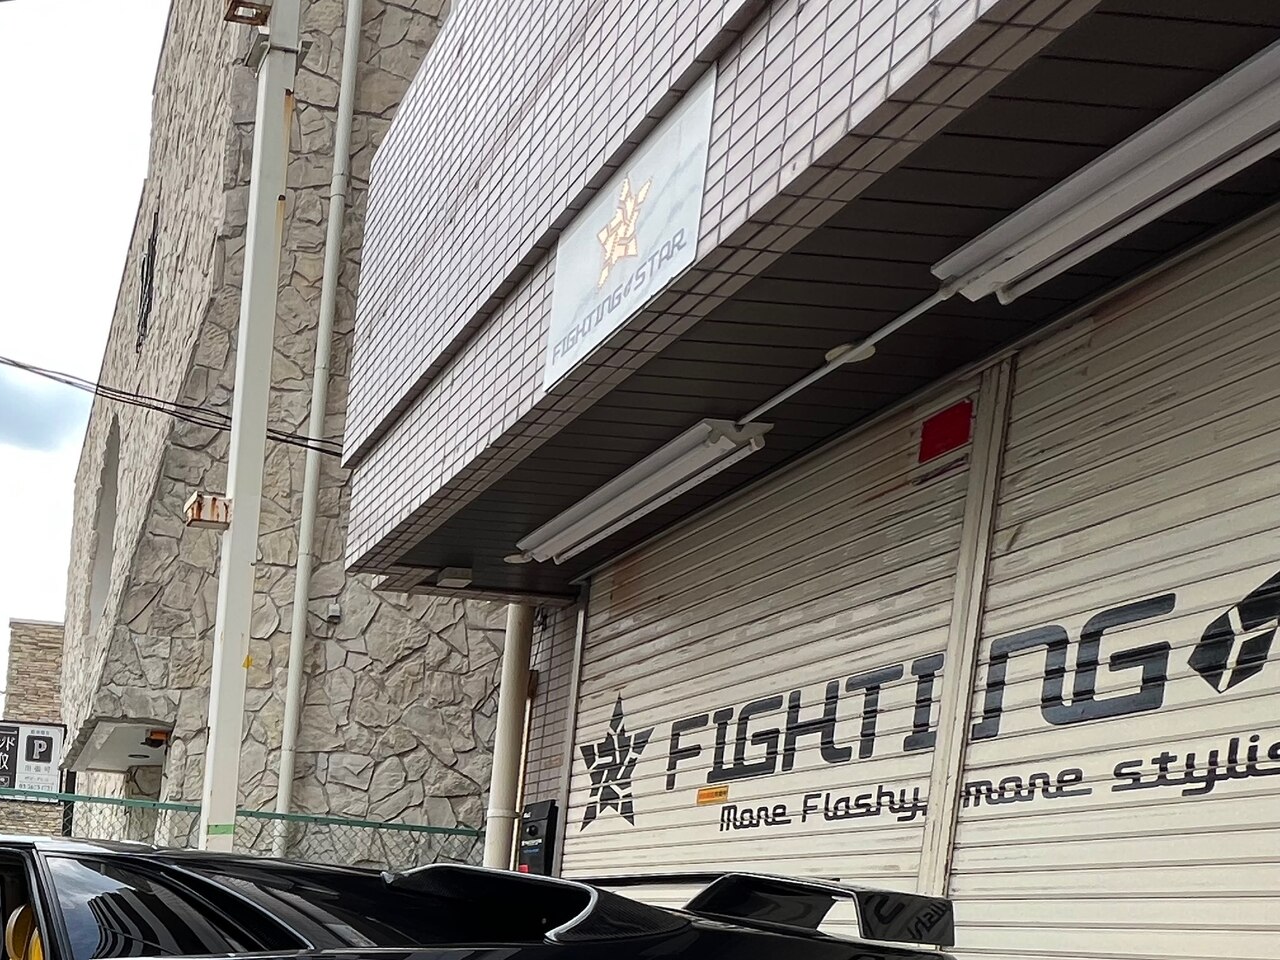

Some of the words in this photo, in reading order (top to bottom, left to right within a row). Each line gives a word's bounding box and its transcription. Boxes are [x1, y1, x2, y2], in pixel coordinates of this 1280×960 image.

[551, 283, 623, 365] FIGHTING
[632, 228, 687, 291] STAR
[32, 739, 48, 759] P
[665, 592, 1177, 790] FIGHTING
